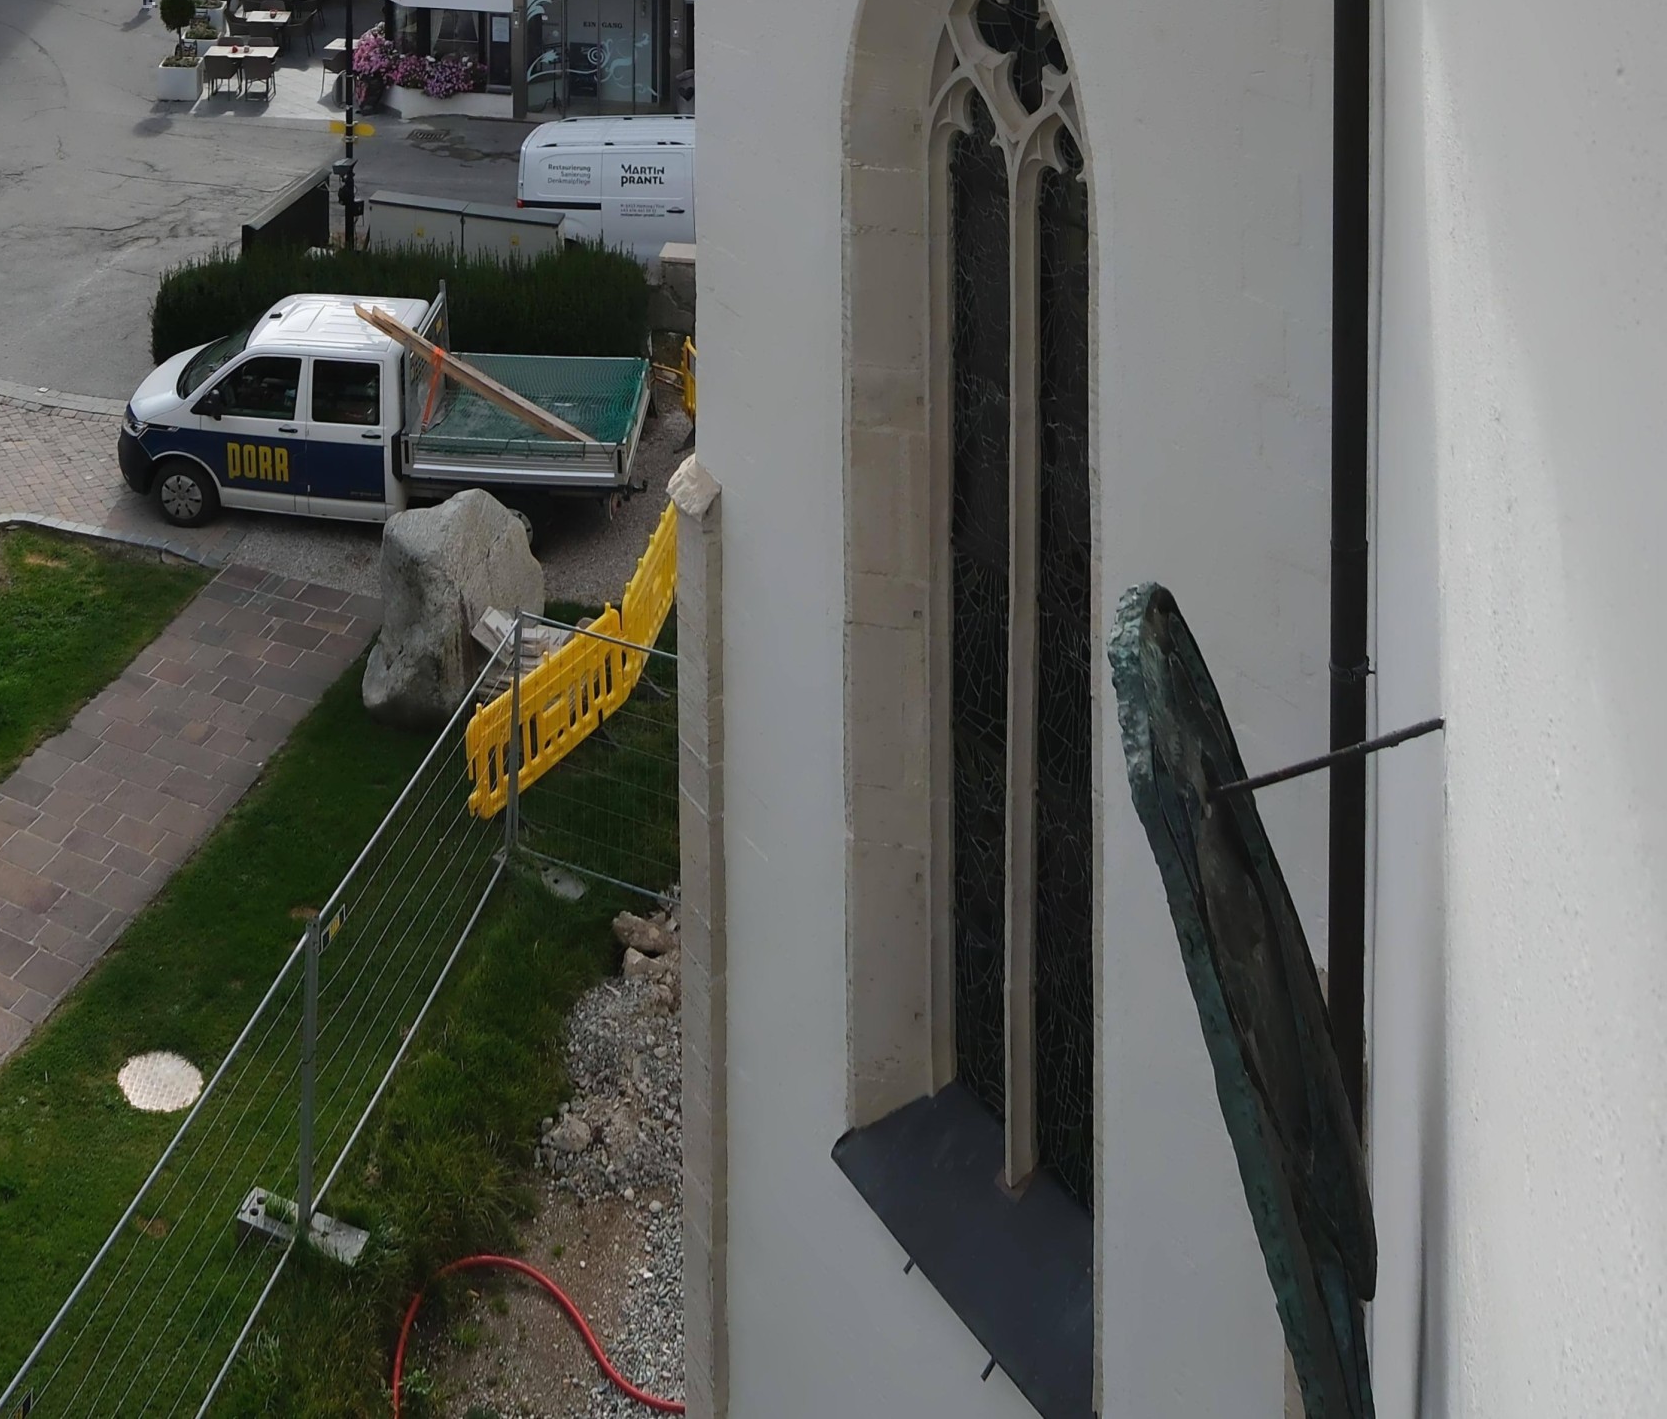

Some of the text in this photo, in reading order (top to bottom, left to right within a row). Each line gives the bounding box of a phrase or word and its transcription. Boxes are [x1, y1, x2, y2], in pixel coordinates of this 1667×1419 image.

[548, 163, 591, 173] Restaurierung
[561, 171, 591, 179] Sanierung
[547, 177, 591, 186] Denkmalpflege
[227, 441, 289, 483] PORR
